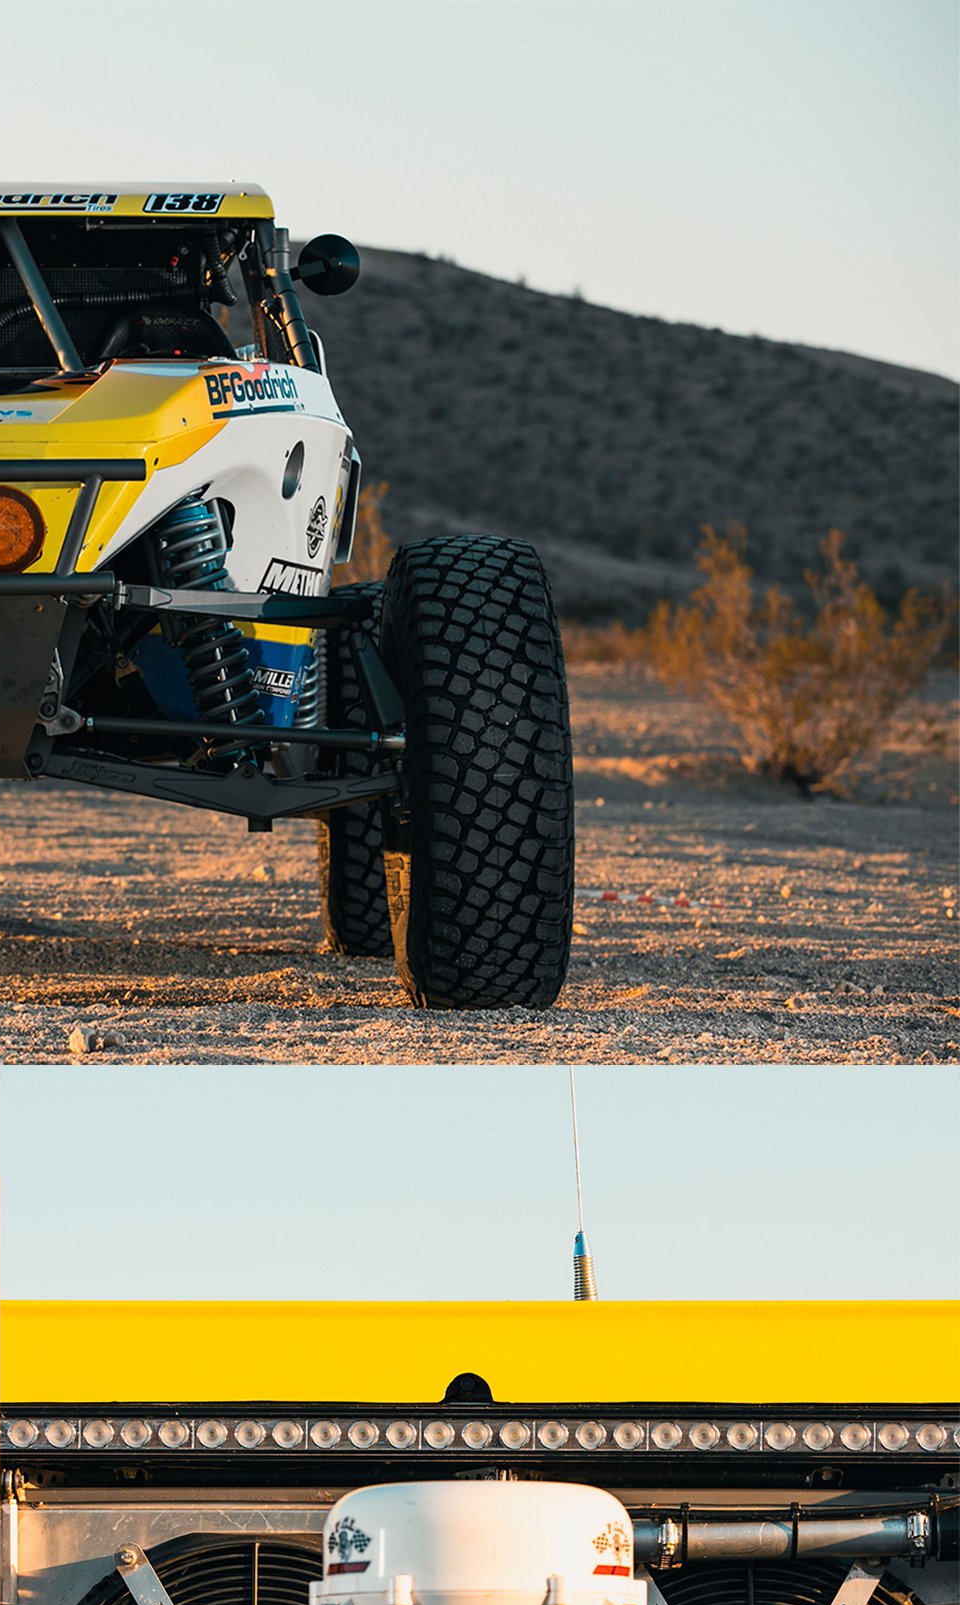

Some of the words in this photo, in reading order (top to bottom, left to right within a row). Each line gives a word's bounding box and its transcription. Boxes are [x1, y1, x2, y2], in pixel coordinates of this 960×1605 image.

[86, 204, 113, 212] Tires
[150, 193, 220, 211] 138
[204, 370, 299, 406] BFGoodrich
